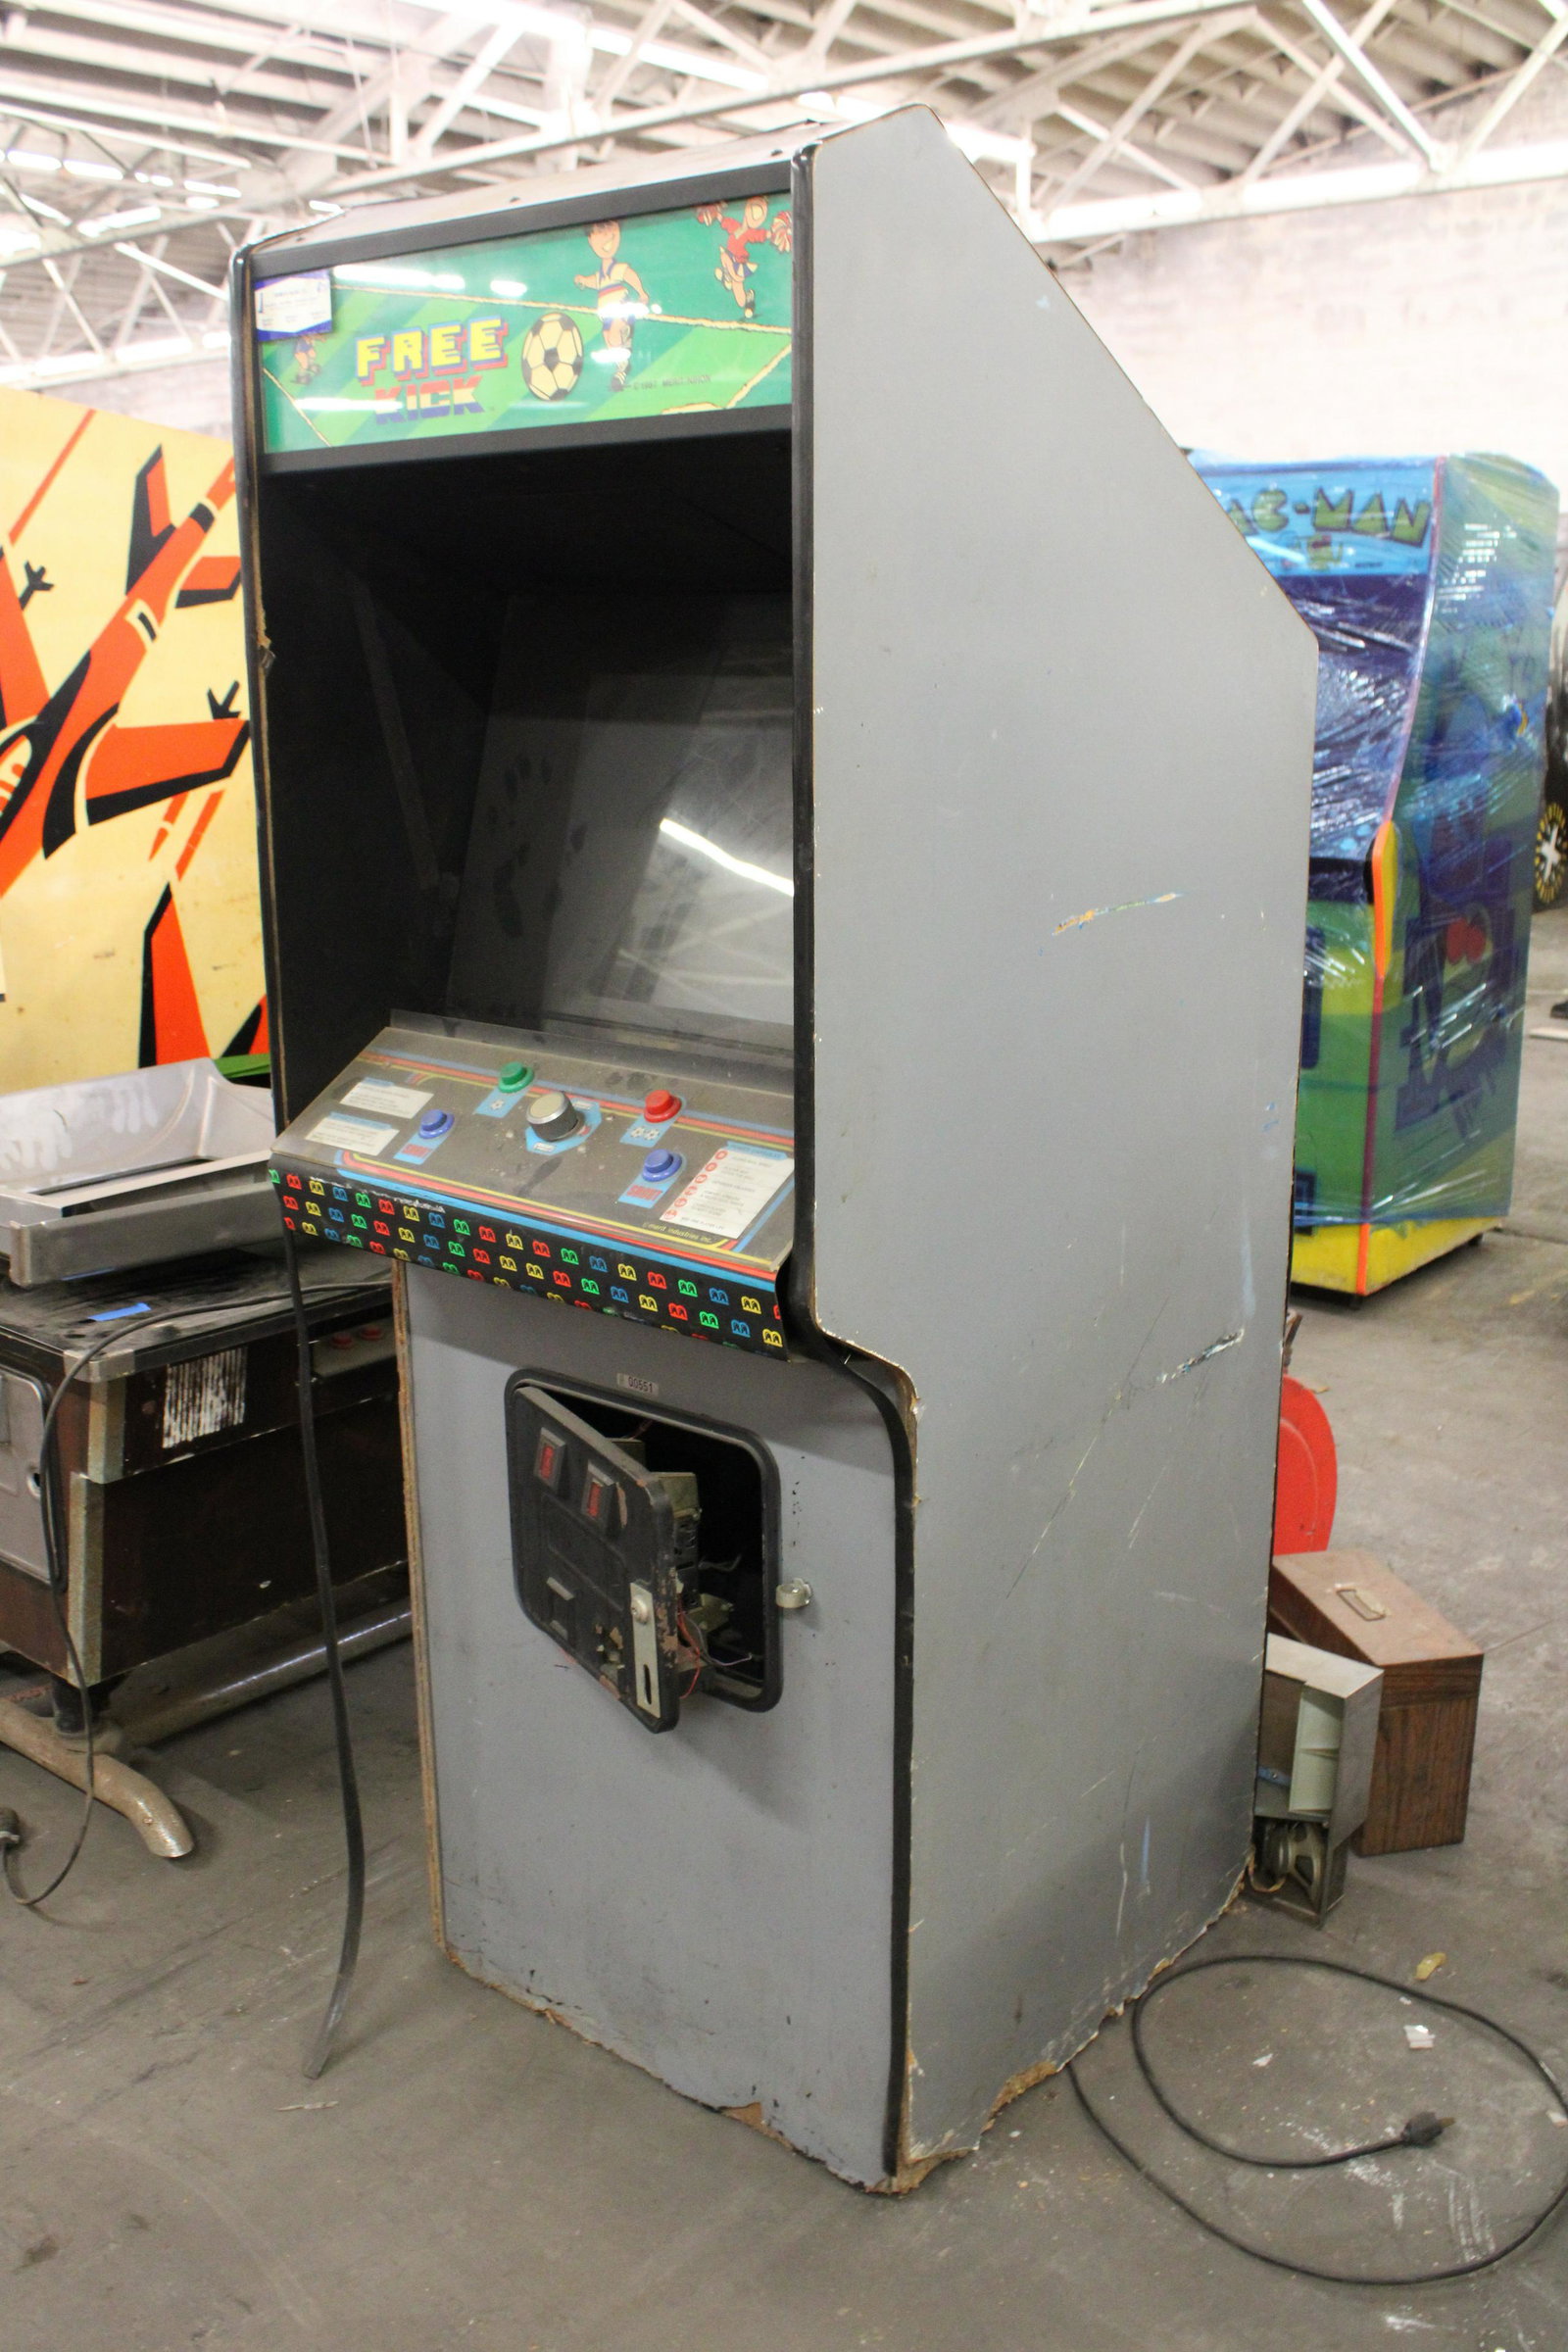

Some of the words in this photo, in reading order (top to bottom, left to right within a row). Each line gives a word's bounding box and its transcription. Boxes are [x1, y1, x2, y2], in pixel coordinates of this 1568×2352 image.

[355, 315, 509, 386] FREE
[374, 374, 485, 425] KICK
[1228, 488, 1431, 548] AC-MAN
